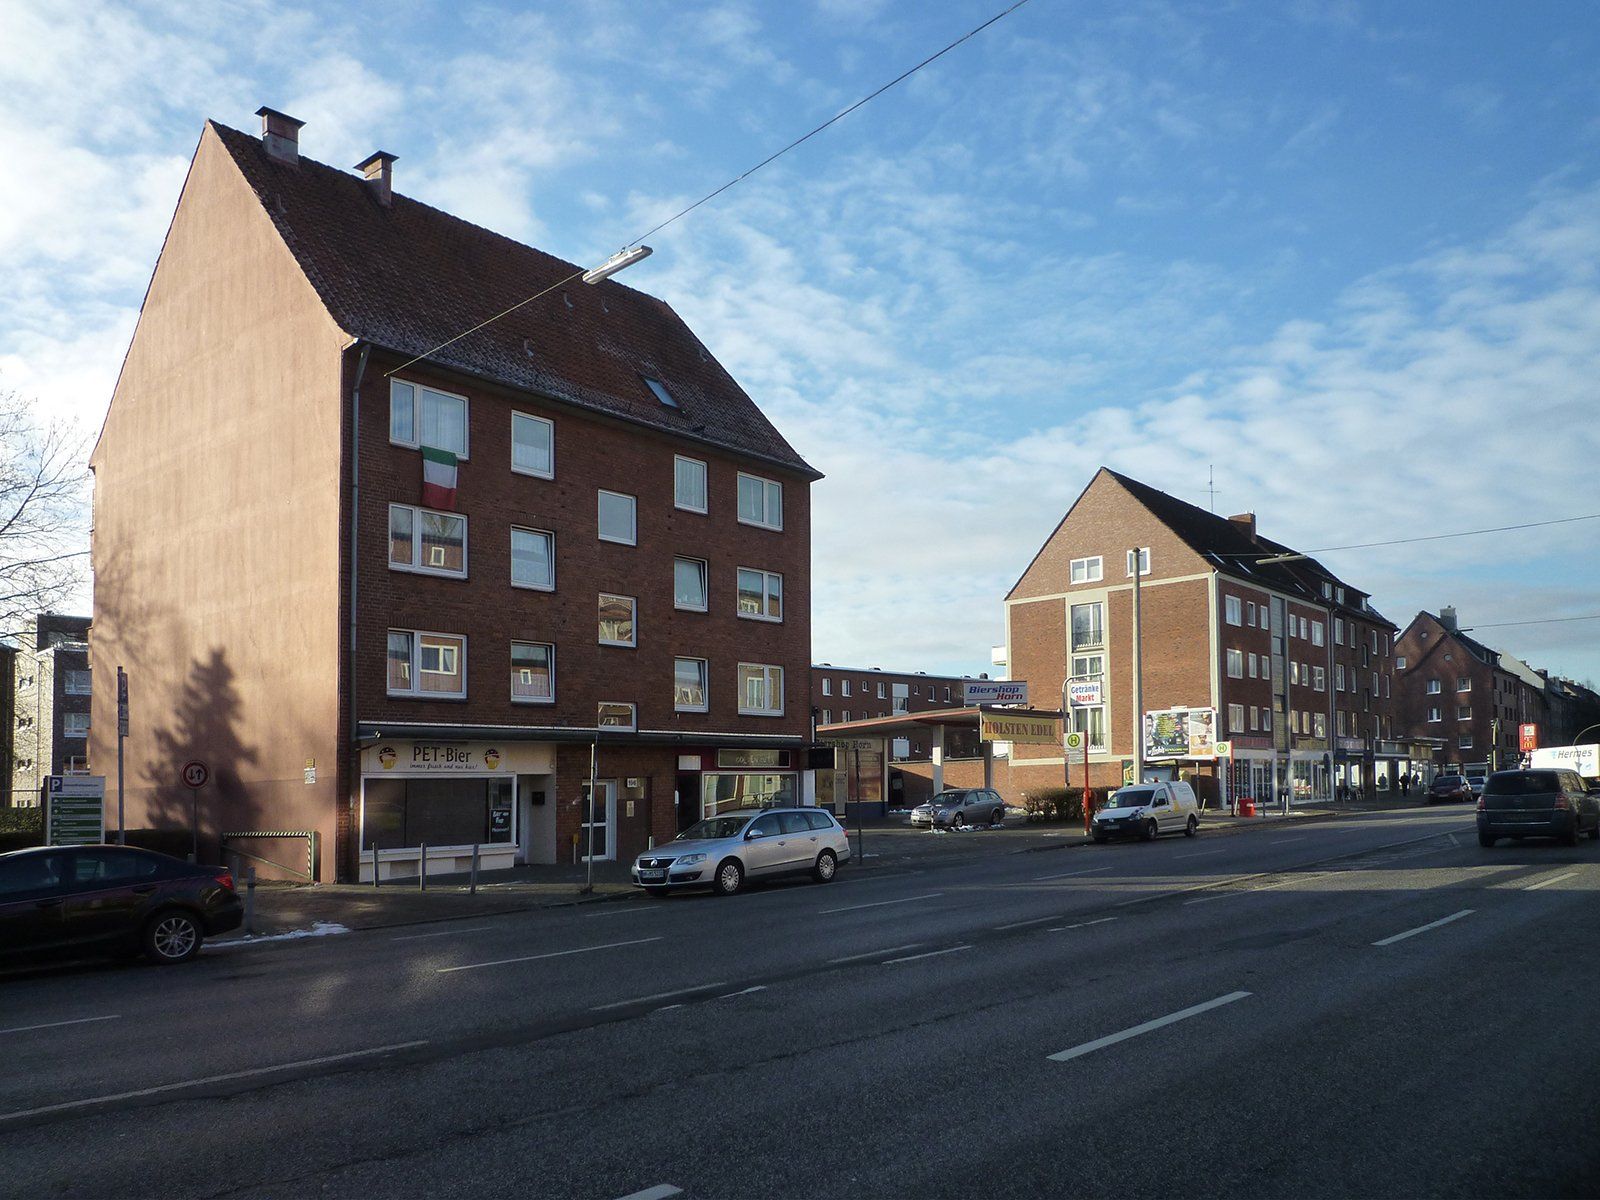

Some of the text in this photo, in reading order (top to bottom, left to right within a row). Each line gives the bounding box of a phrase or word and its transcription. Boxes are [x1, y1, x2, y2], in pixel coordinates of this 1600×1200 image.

[969, 685, 1020, 694] Biershop
[1076, 694, 1095, 702] Markt
[984, 721, 1055, 737] HOLSTEN EDEL
[852, 740, 872, 749] Horn
[413, 746, 472, 763] PET-Bier
[1557, 749, 1593, 759] Hermes
[52, 779, 60, 791] P
